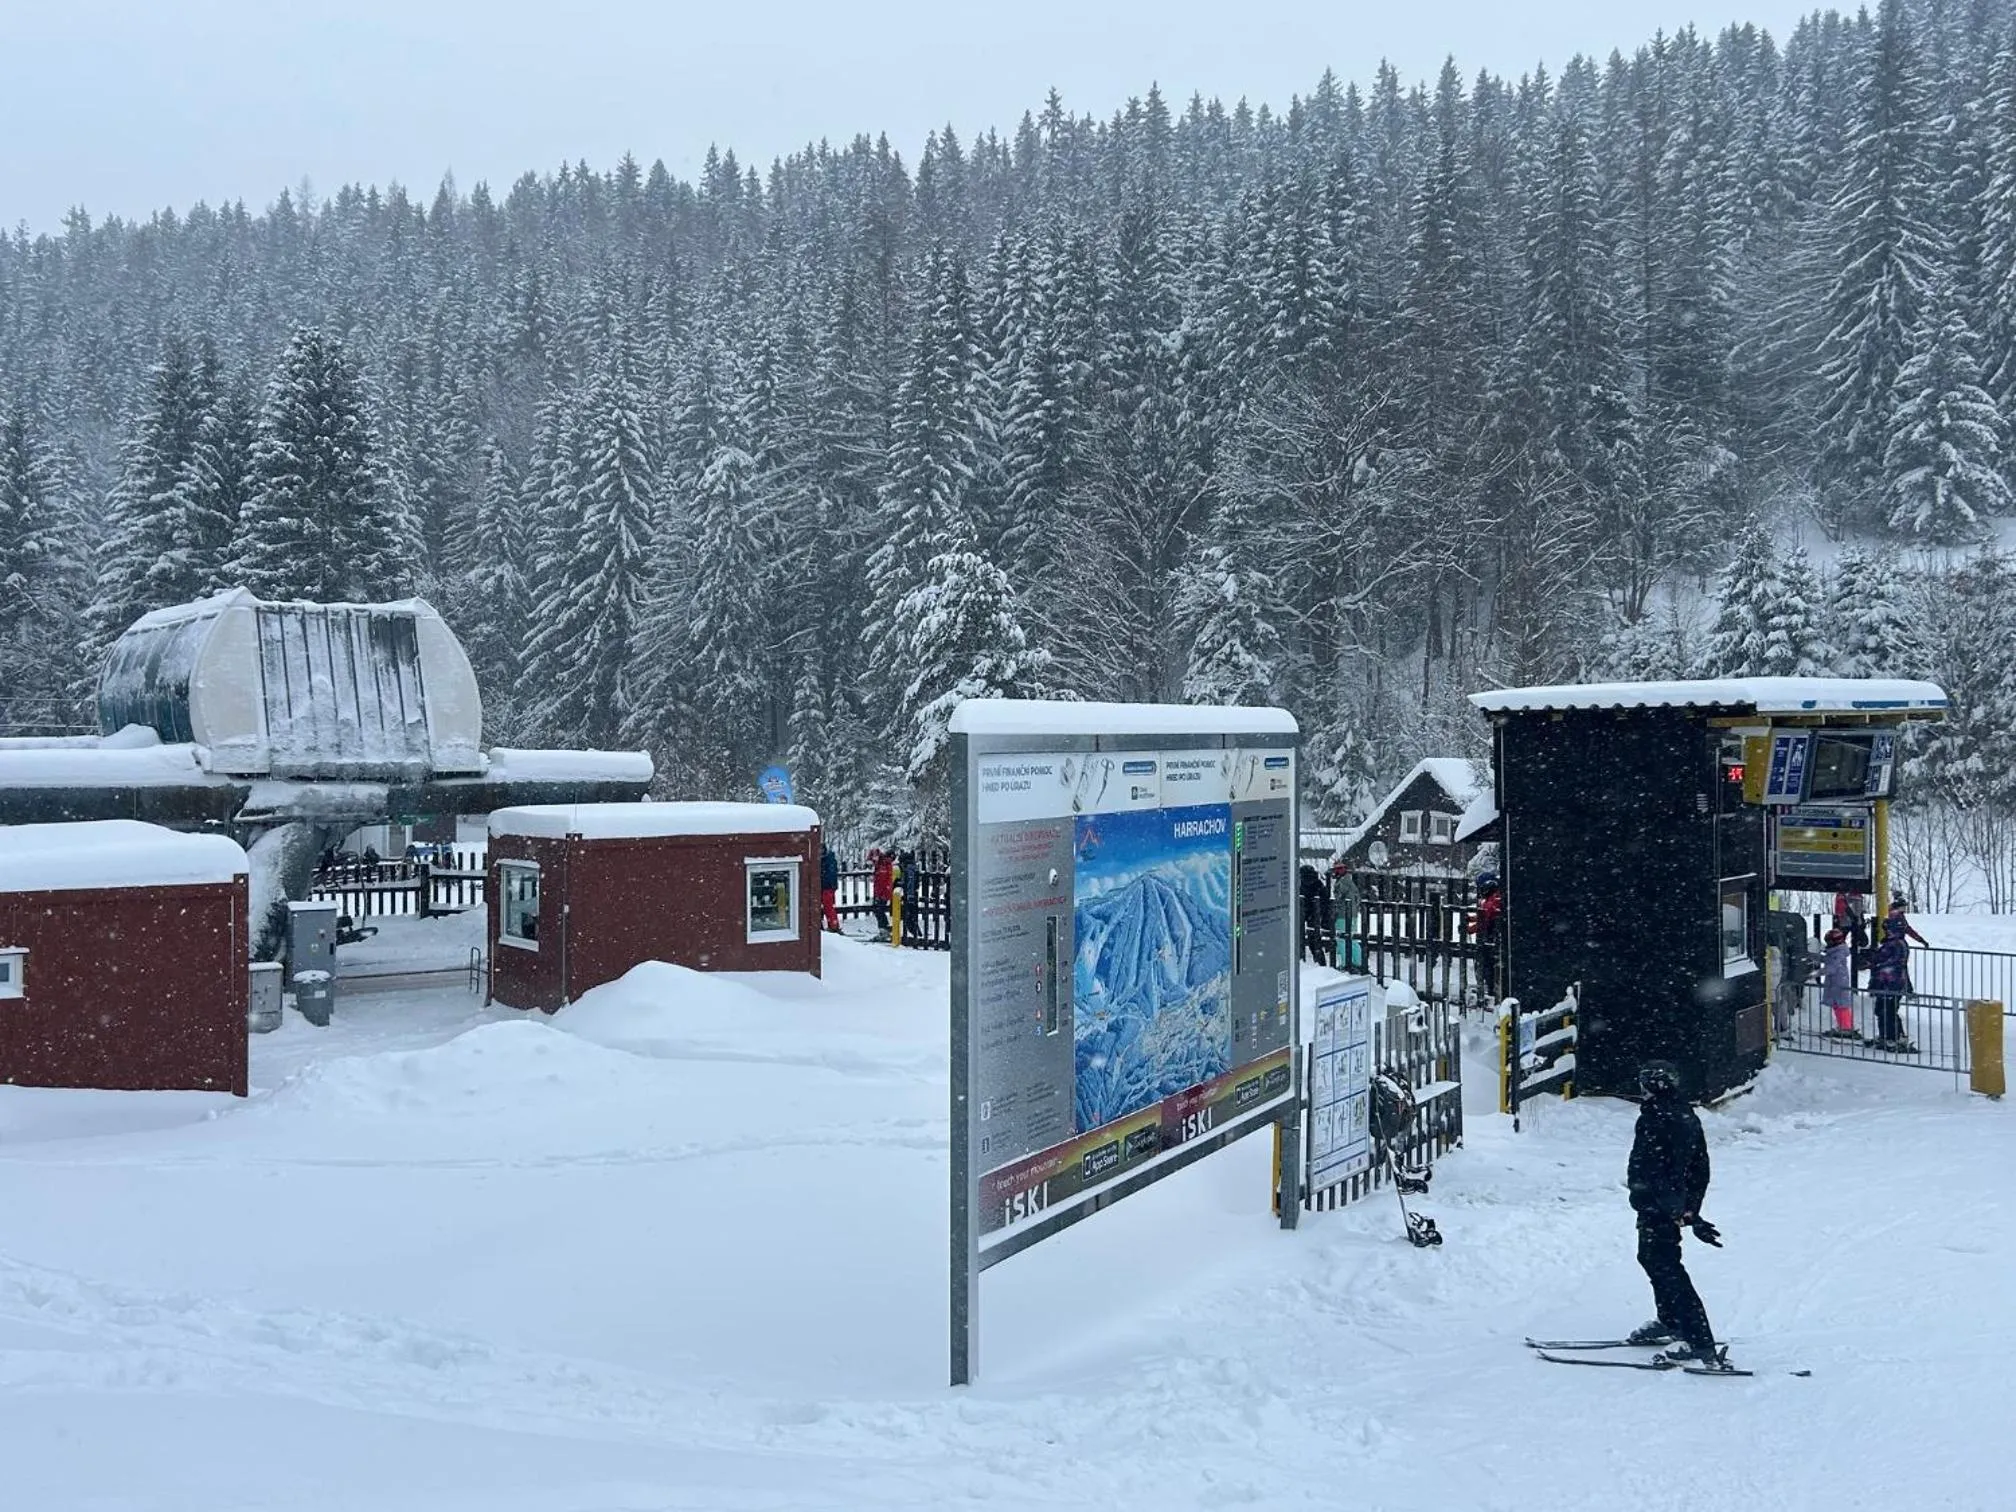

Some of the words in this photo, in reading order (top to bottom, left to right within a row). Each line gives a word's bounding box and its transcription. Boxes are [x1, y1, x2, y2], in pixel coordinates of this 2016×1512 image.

[1174, 818, 1227, 839] HARRACHOV
[1182, 1106, 1212, 1142] iSKI
[1005, 1180, 1048, 1228] iSKI
